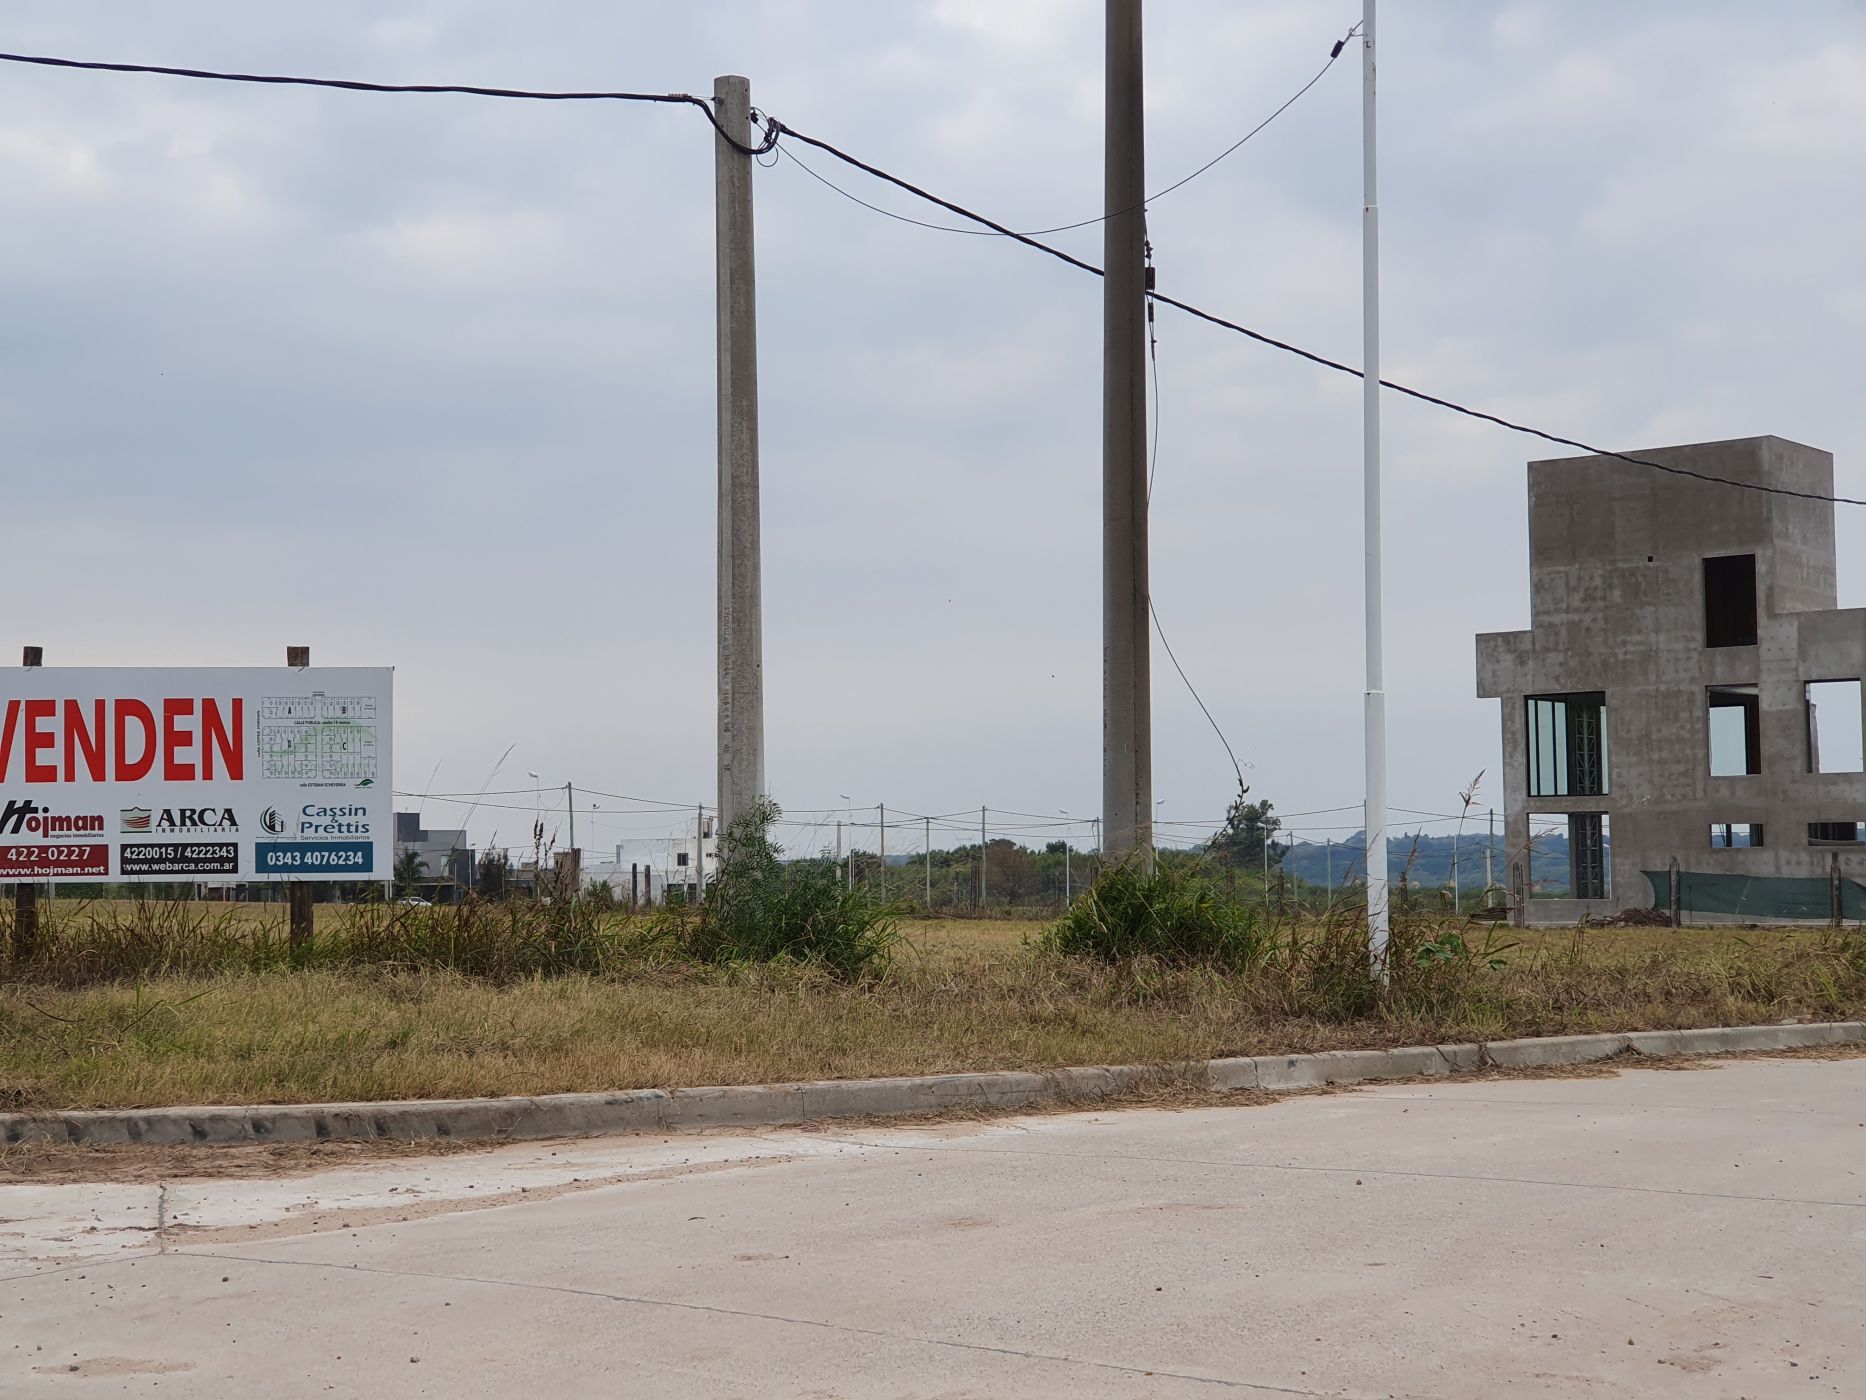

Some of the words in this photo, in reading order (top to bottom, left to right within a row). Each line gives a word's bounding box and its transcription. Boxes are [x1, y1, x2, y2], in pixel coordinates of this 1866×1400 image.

[302, 804, 367, 817] Cassin
[0, 800, 104, 838] Hojman
[155, 808, 240, 828] ARCA
[301, 821, 370, 834] Prettis
[7, 846, 91, 861] 422-0227
[124, 846, 174, 859] 4220015
[176, 846, 182, 859] /
[185, 846, 235, 858] 4222343
[267, 852, 301, 865] 0343
[304, 851, 364, 865] 4076234
[0, 866, 105, 876] www.hojman.net
[123, 862, 235, 871] www.webarca.com.ar
